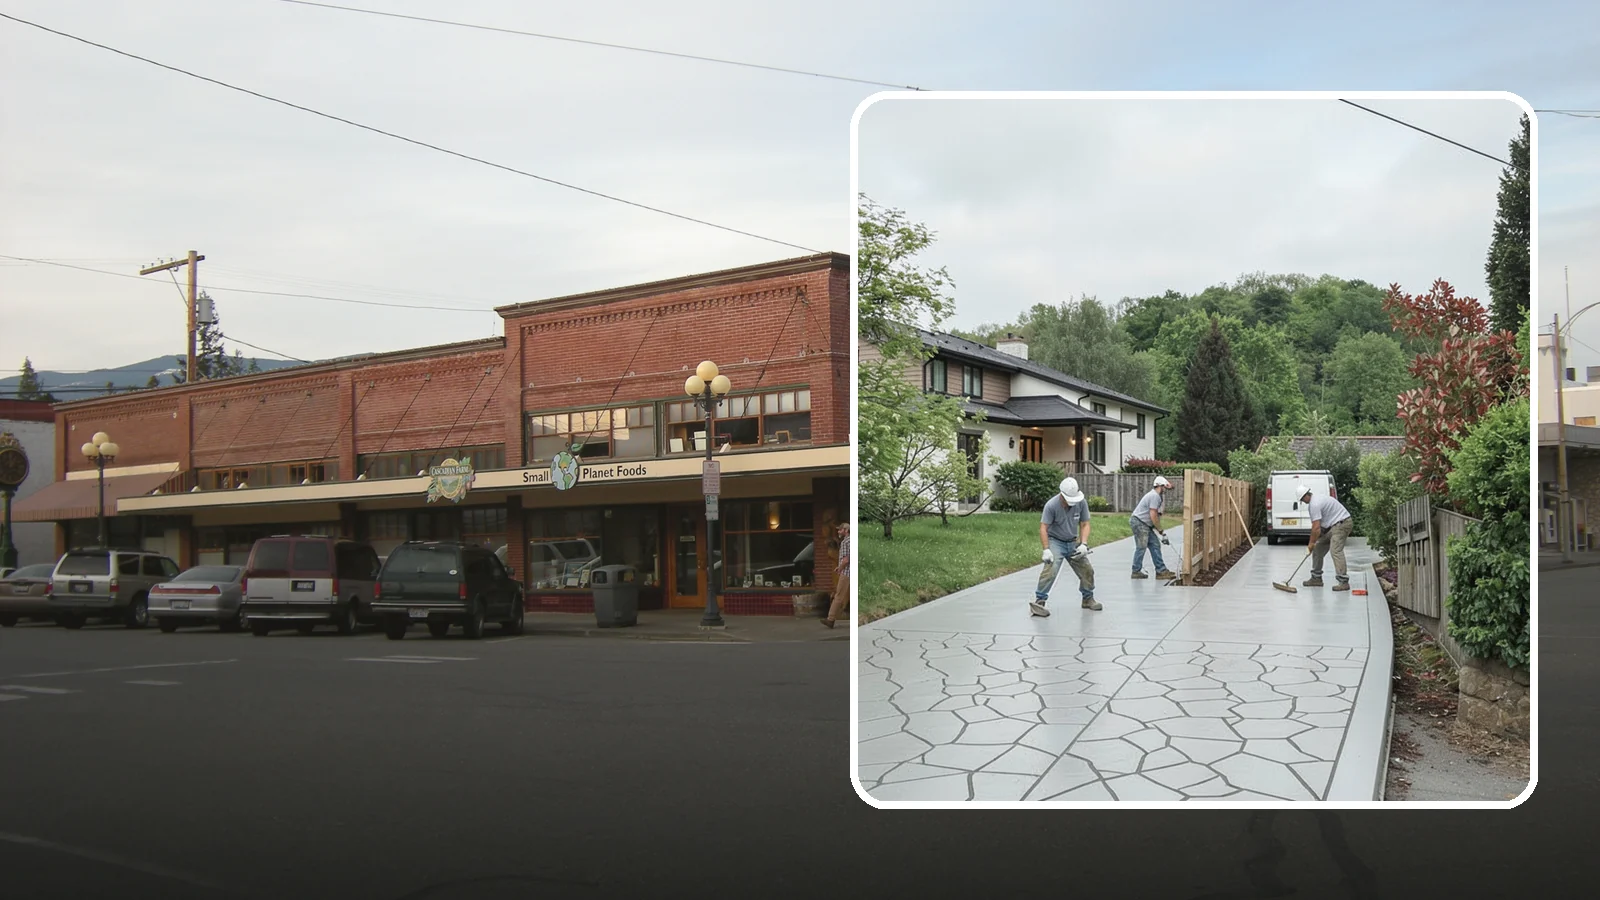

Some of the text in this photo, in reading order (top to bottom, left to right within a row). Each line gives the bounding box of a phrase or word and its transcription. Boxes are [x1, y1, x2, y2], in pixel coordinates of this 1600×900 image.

[431, 466, 469, 476] CASCADIAN FARM
[523, 464, 647, 483] Small Planet Foods
